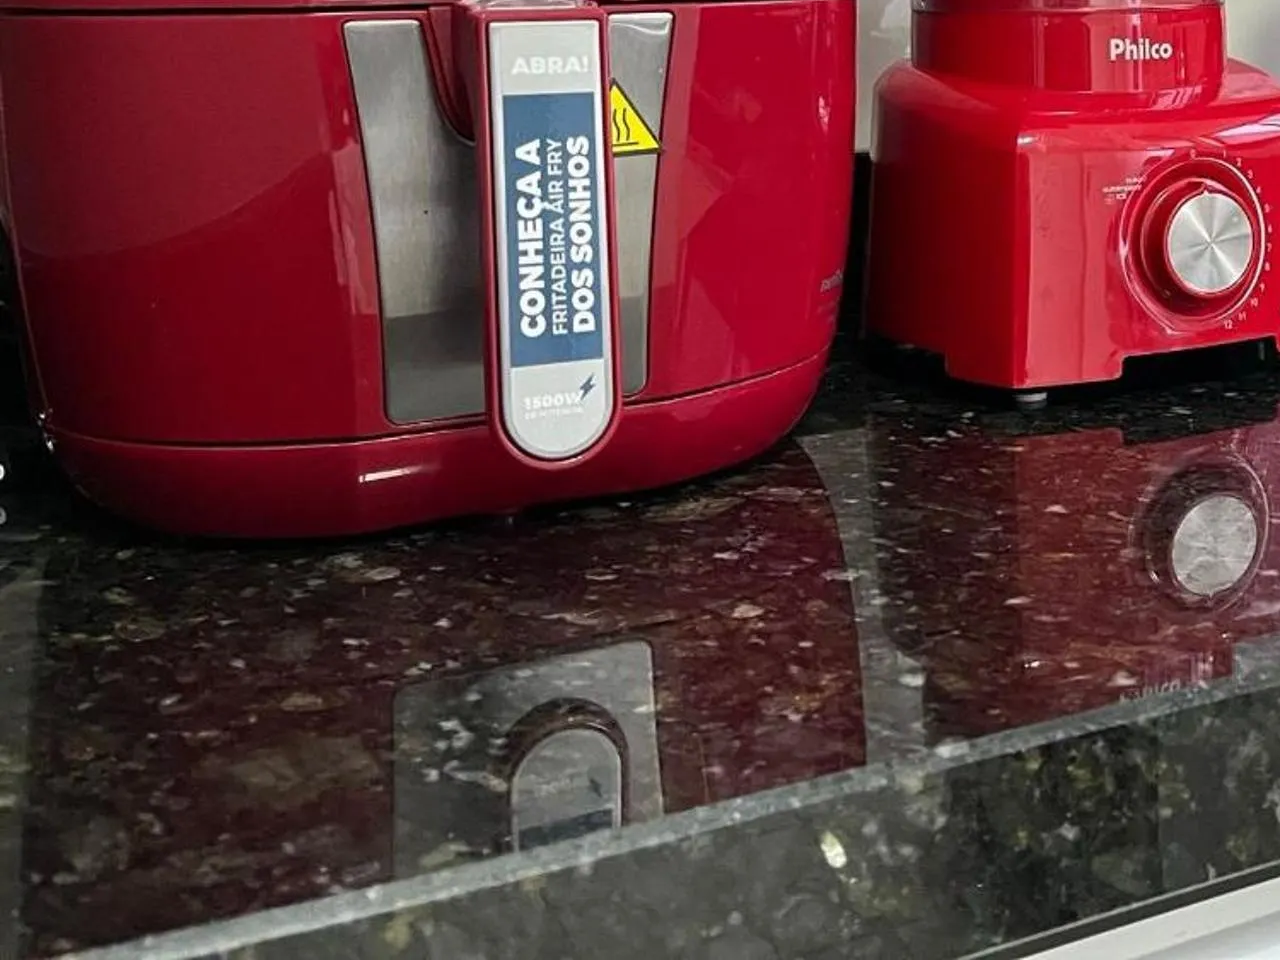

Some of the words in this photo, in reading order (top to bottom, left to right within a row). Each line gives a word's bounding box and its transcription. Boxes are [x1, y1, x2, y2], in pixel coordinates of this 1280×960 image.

[511, 54, 590, 76] ABRA!
[1109, 37, 1174, 61] Philco
[514, 137, 542, 166] A
[545, 137, 564, 177] FRY
[547, 179, 565, 215] AIR
[565, 134, 594, 264] SONHOS
[515, 170, 551, 338] CONHEÇA
[549, 217, 569, 336] FRITADEIRA
[570, 267, 596, 334] DOS
[523, 391, 582, 411] 1500W
